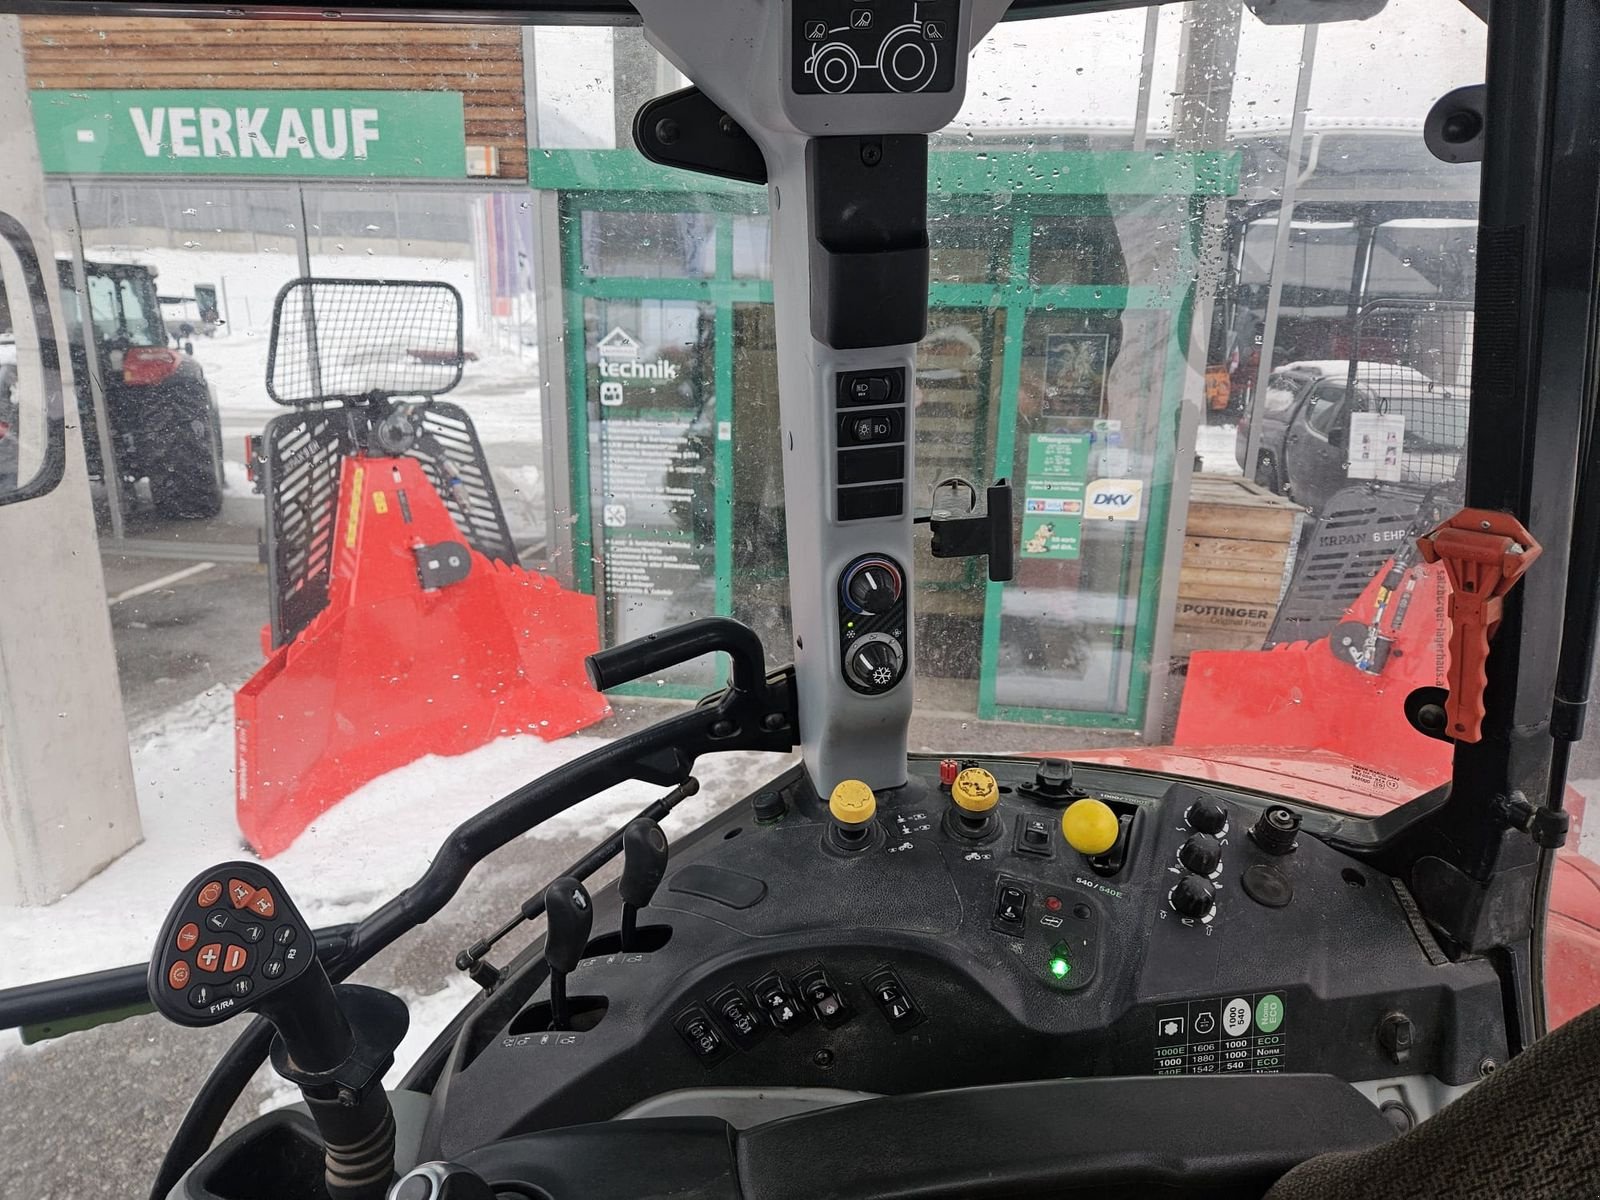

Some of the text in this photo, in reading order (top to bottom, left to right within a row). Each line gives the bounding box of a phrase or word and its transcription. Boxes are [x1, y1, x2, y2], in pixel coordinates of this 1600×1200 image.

[130, 107, 379, 160] VERKAUF
[598, 358, 677, 379] technik
[1093, 493, 1134, 506] DKV
[1319, 529, 1406, 547] KRPAN 6 EHP
[1209, 616, 1267, 628] Original Parts
[1433, 570, 1448, 686] salzburger-lagerhaus.a
[287, 948, 297, 959] R3
[210, 998, 234, 1014] F1/R4
[1269, 1002, 1277, 1023] ECO
[1229, 1006, 1237, 1028] 1000
[1156, 1036, 1279, 1057] 1000E 1606 1000 ECO
[1159, 1058, 1182, 1067] 1000
[1193, 1054, 1215, 1063] 1880
[1225, 1050, 1247, 1059] 1000
[1192, 1065, 1214, 1074] 1542
[1226, 1061, 1244, 1070] 540
[1257, 1058, 1278, 1066] ECO
